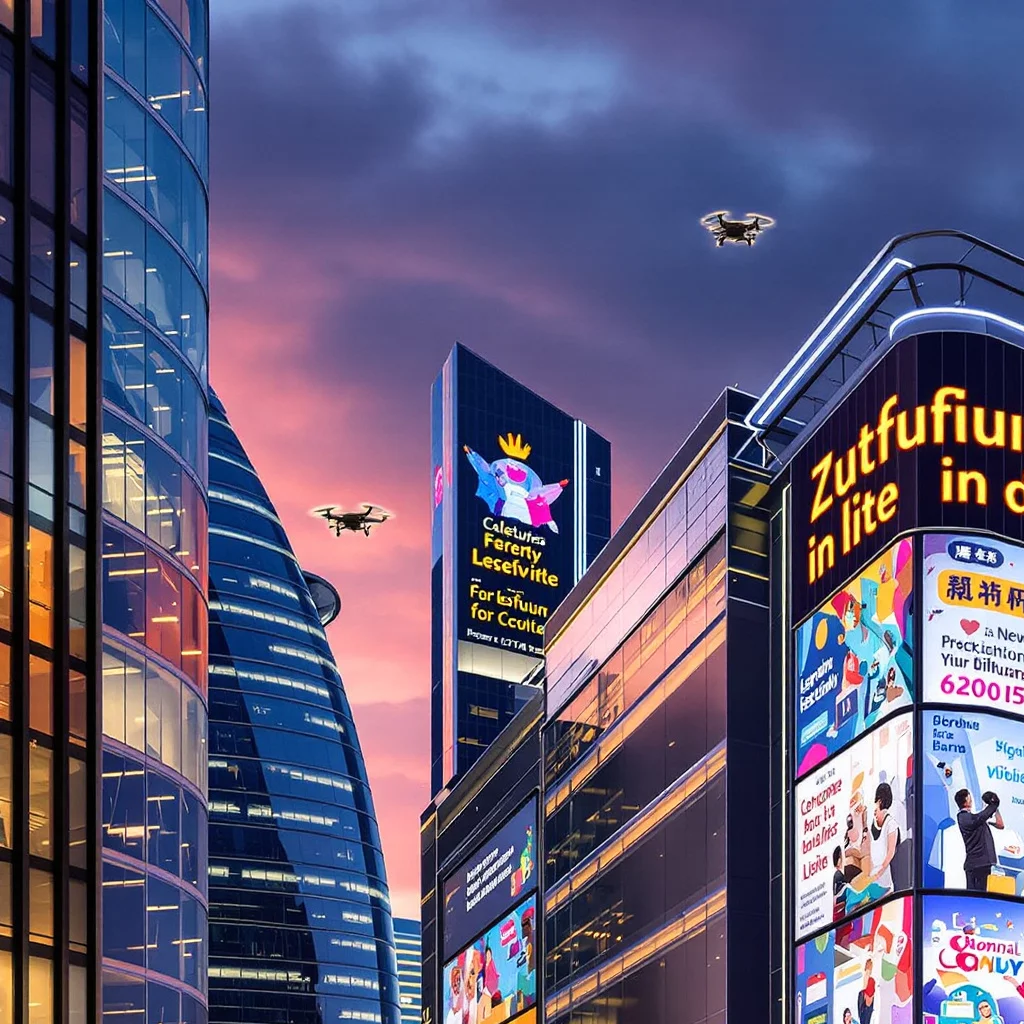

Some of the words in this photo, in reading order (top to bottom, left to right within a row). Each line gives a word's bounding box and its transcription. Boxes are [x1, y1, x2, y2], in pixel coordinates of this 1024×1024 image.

[808, 532, 834, 584] in
[842, 481, 899, 555] lite
[941, 456, 987, 505] in
[471, 602, 495, 622] for
